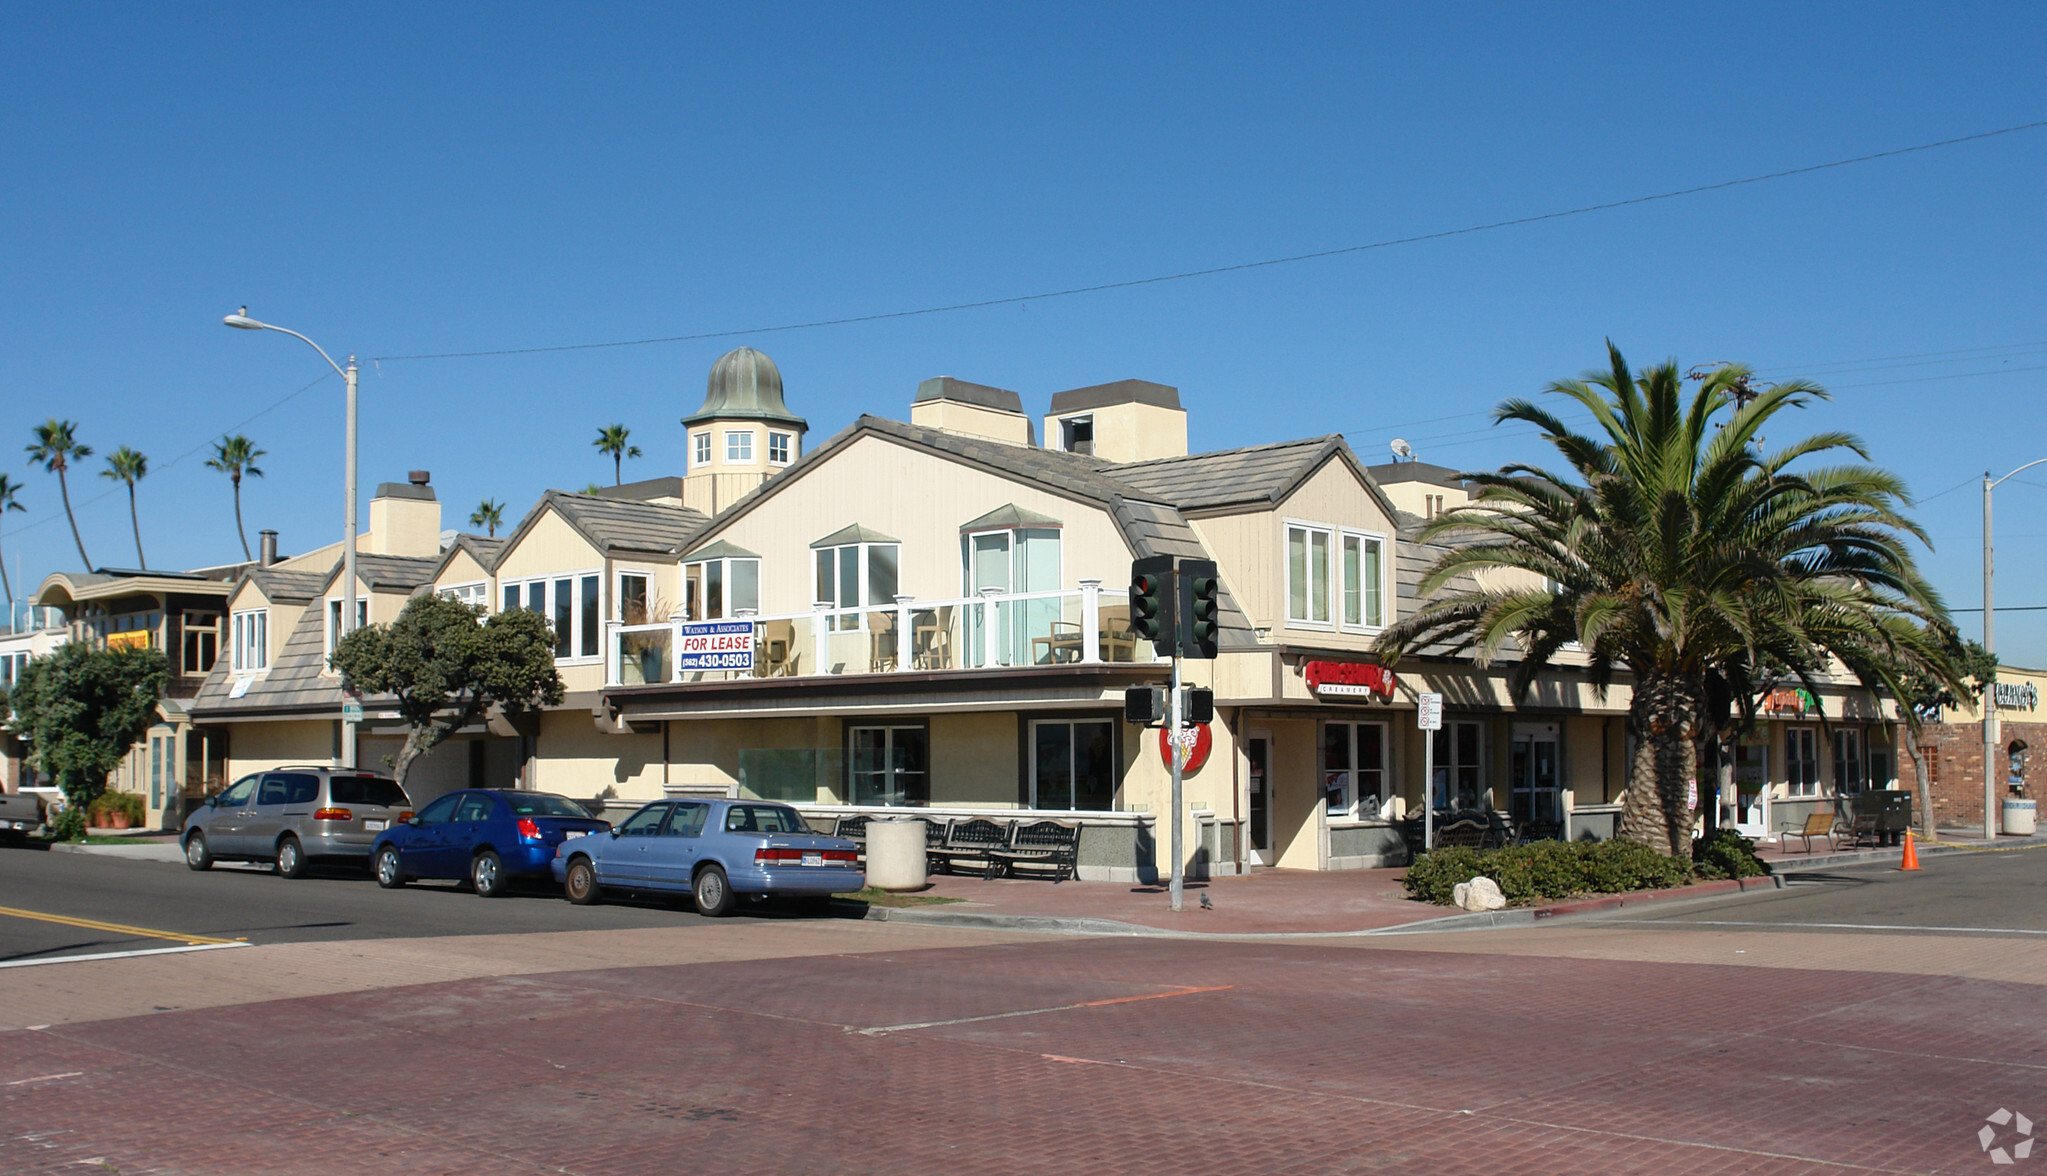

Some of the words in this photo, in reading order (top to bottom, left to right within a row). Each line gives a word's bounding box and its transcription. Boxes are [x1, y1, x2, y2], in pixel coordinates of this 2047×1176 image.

[684, 626, 708, 634] WATSON
[716, 624, 749, 633] ASSOCIATES
[684, 637, 707, 651] FOR
[711, 636, 750, 650] LEASE
[698, 653, 749, 667] 430-0503
[1322, 685, 1368, 693] CREAMERY
